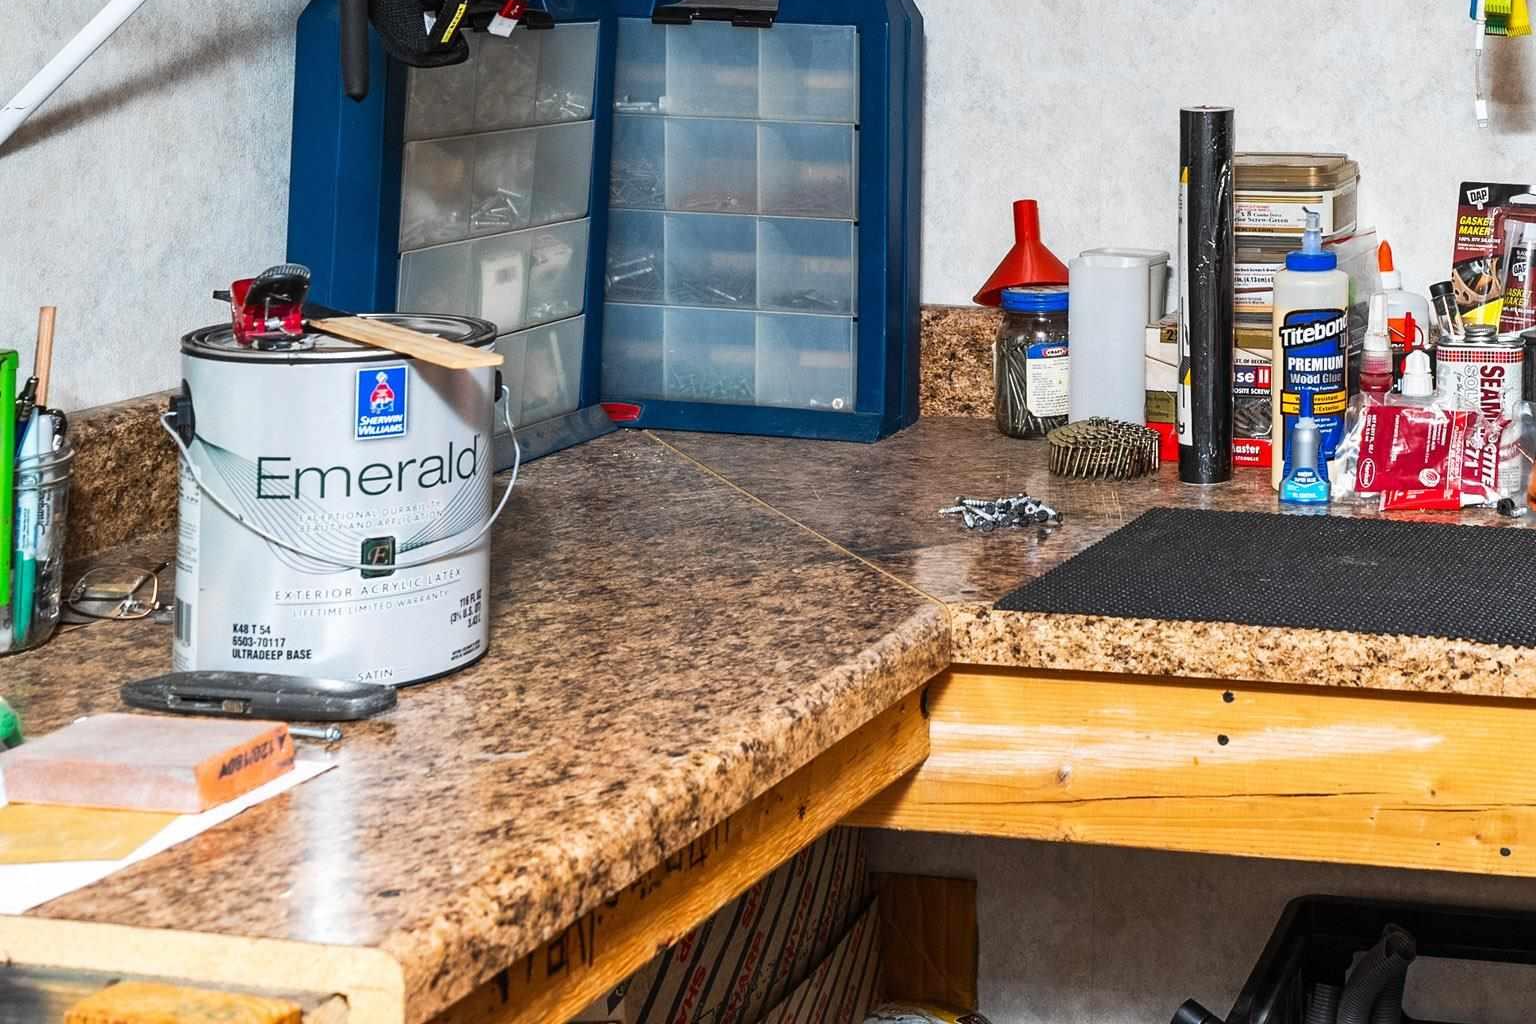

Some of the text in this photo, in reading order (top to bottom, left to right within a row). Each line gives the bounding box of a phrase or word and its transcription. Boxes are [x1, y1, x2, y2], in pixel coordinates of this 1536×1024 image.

[1459, 216, 1495, 226] GASKET
[1458, 226, 1491, 236] MAKER
[1287, 356, 1344, 372] PREMIUM
[1290, 373, 1342, 384] Wood Glue
[360, 414, 403, 425] SHERWIN
[358, 424, 403, 435] WILLIAMS
[256, 435, 476, 500] Emerald
[1363, 460, 1372, 486] Henkel
[275, 568, 461, 601] EXTERIOR ACRYLIC LATEX
[293, 590, 449, 617] LIFETIME LIMITED WARRANTY
[232, 624, 271, 635] K48 T 54
[232, 649, 312, 660] ULTRADEEP BASE
[358, 668, 393, 681] SATIN
